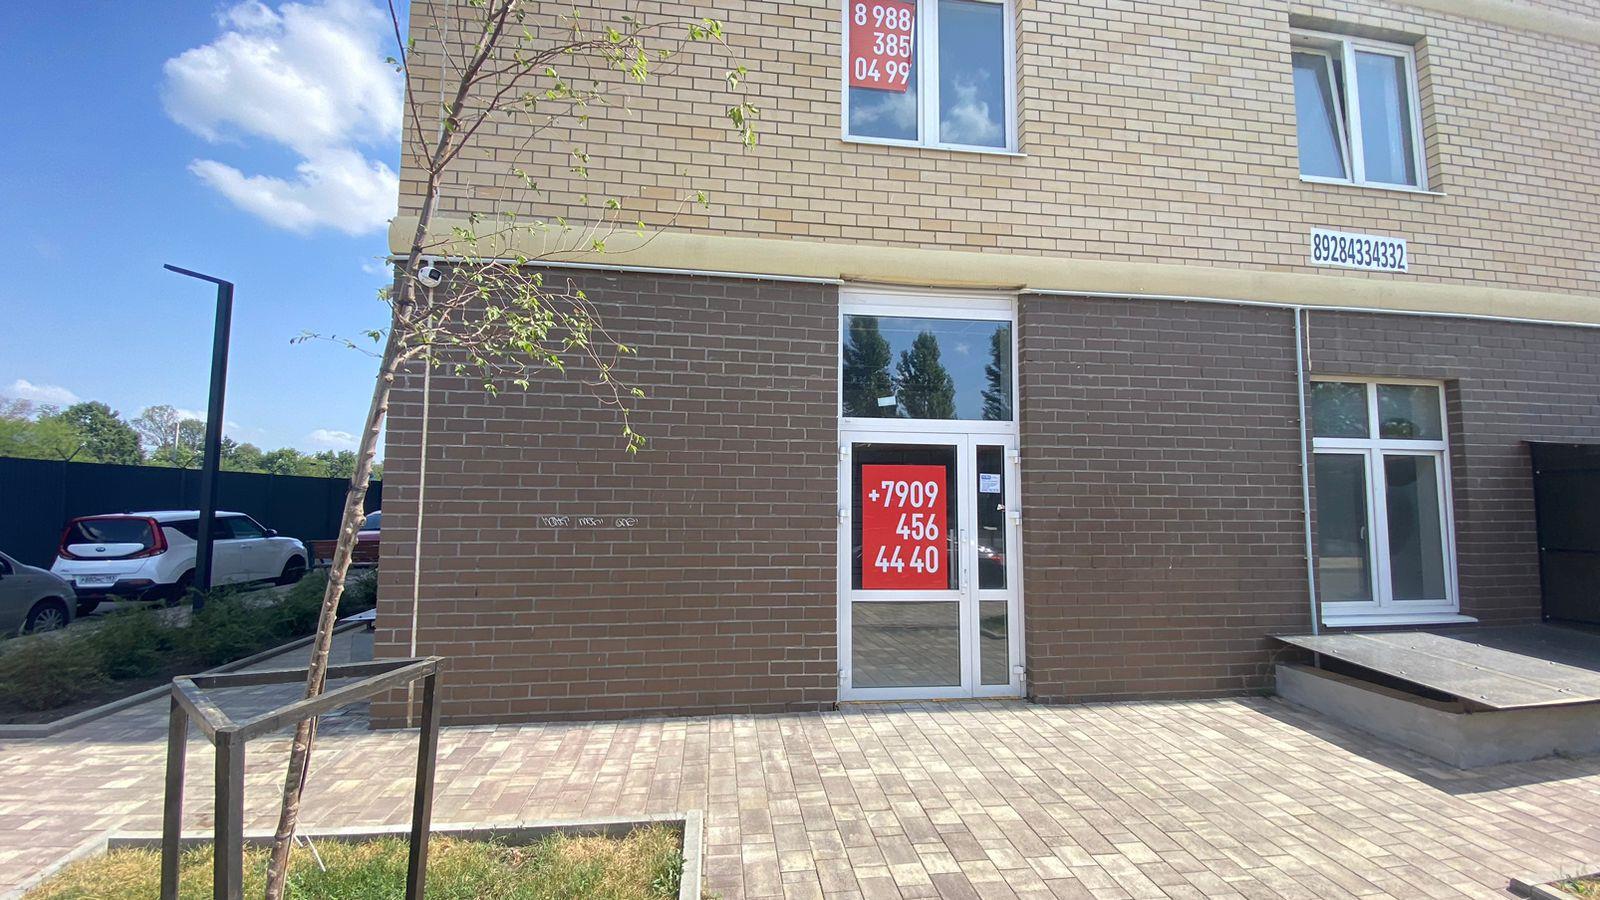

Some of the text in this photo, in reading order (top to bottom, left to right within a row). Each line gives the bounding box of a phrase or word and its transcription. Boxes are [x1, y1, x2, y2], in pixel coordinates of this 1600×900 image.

[855, 3, 911, 31] 8 988
[873, 32, 910, 58] 385
[1313, 233, 1405, 269] 89284334332
[868, 480, 939, 508] +7909
[896, 513, 939, 541] 456
